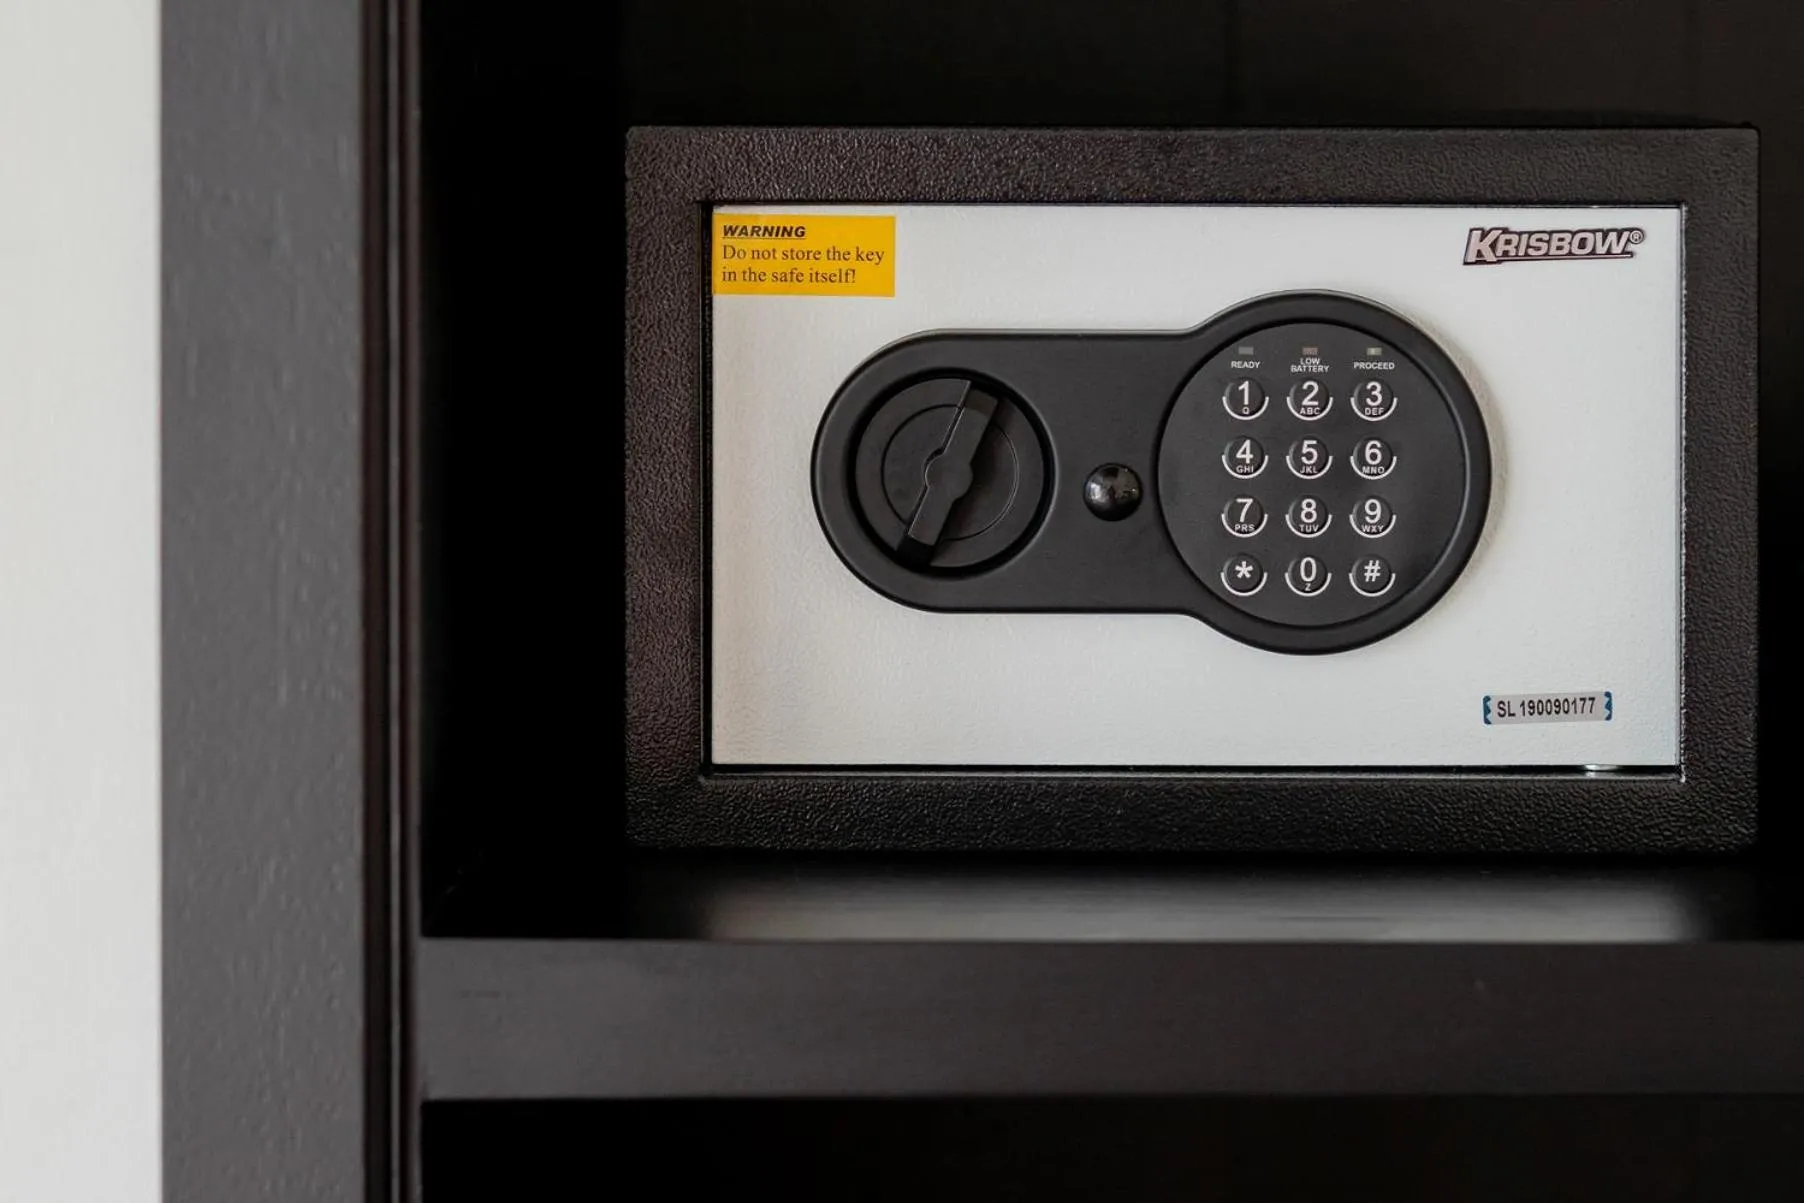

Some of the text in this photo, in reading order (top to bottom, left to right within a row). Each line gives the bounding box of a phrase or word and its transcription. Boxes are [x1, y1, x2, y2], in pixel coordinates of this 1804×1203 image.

[722, 224, 806, 239] WARNING
[722, 244, 885, 266] Do not store the key
[722, 266, 856, 284] in the safe itself!
[1230, 360, 1261, 369] READY
[1290, 364, 1330, 373] BATTERY
[1300, 357, 1321, 365] LOW
[1353, 361, 1396, 371] PROCEED
[1238, 380, 1250, 406] 1
[1302, 380, 1320, 407] 2
[1365, 381, 1383, 407] 3
[1299, 406, 1321, 416] ABC
[1364, 407, 1385, 416] DEF
[1235, 439, 1254, 465] 4
[1300, 440, 1318, 466] 5
[1364, 440, 1383, 466] 6
[1235, 464, 1255, 474] GHI
[1300, 465, 1319, 475] JKL
[1361, 465, 1386, 475] MNO
[1236, 498, 1254, 524] 7
[1300, 498, 1318, 524] 8
[1364, 498, 1382, 525] 9
[1234, 523, 1256, 533] PRS
[1299, 524, 1320, 533] TUV
[1361, 524, 1385, 534] WXY
[1299, 557, 1317, 583] 0
[1364, 559, 1382, 583] #
[1496, 696, 1597, 718] SL 190090177
